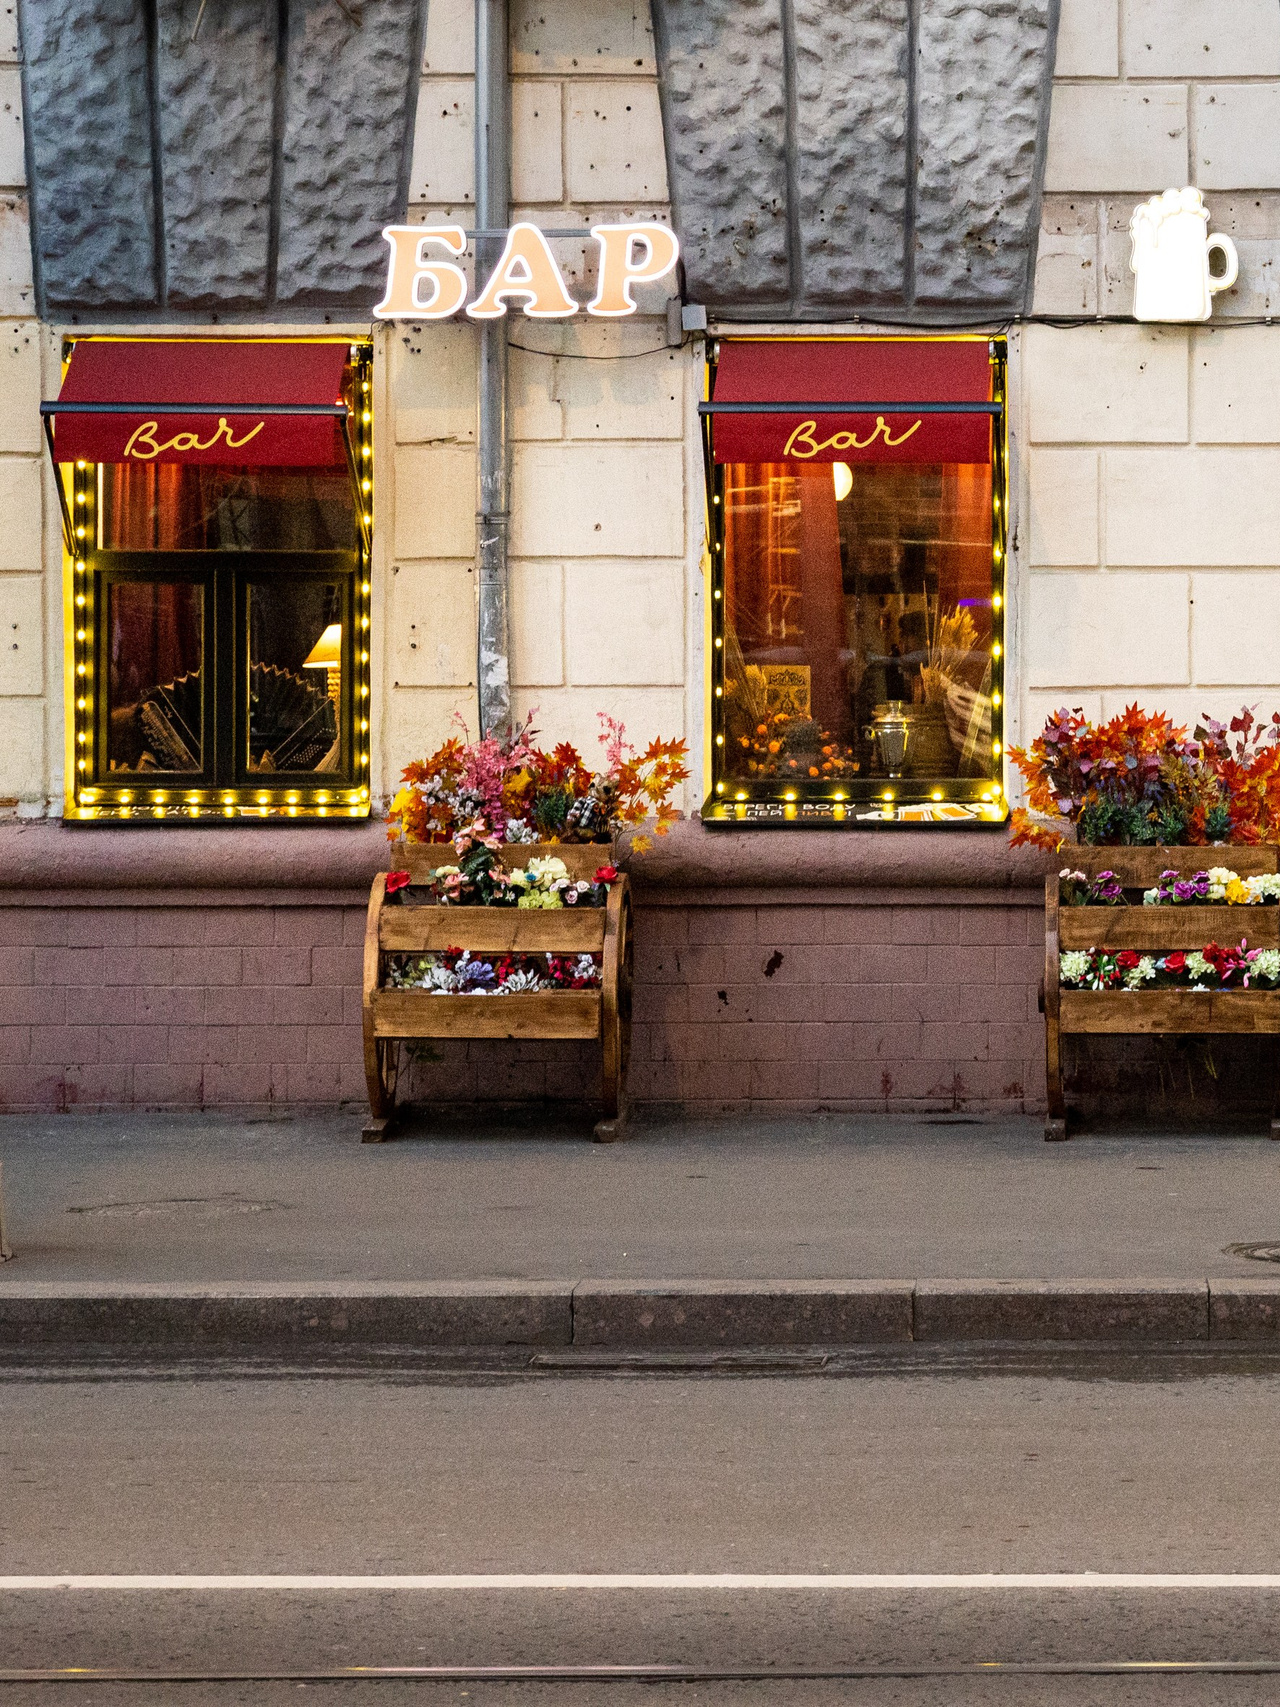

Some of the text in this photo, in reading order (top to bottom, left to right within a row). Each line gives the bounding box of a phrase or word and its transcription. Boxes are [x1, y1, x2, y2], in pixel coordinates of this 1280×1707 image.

[373, 222, 679, 318] БАР
[124, 418, 265, 459] Bar
[783, 416, 922, 459] Bar
